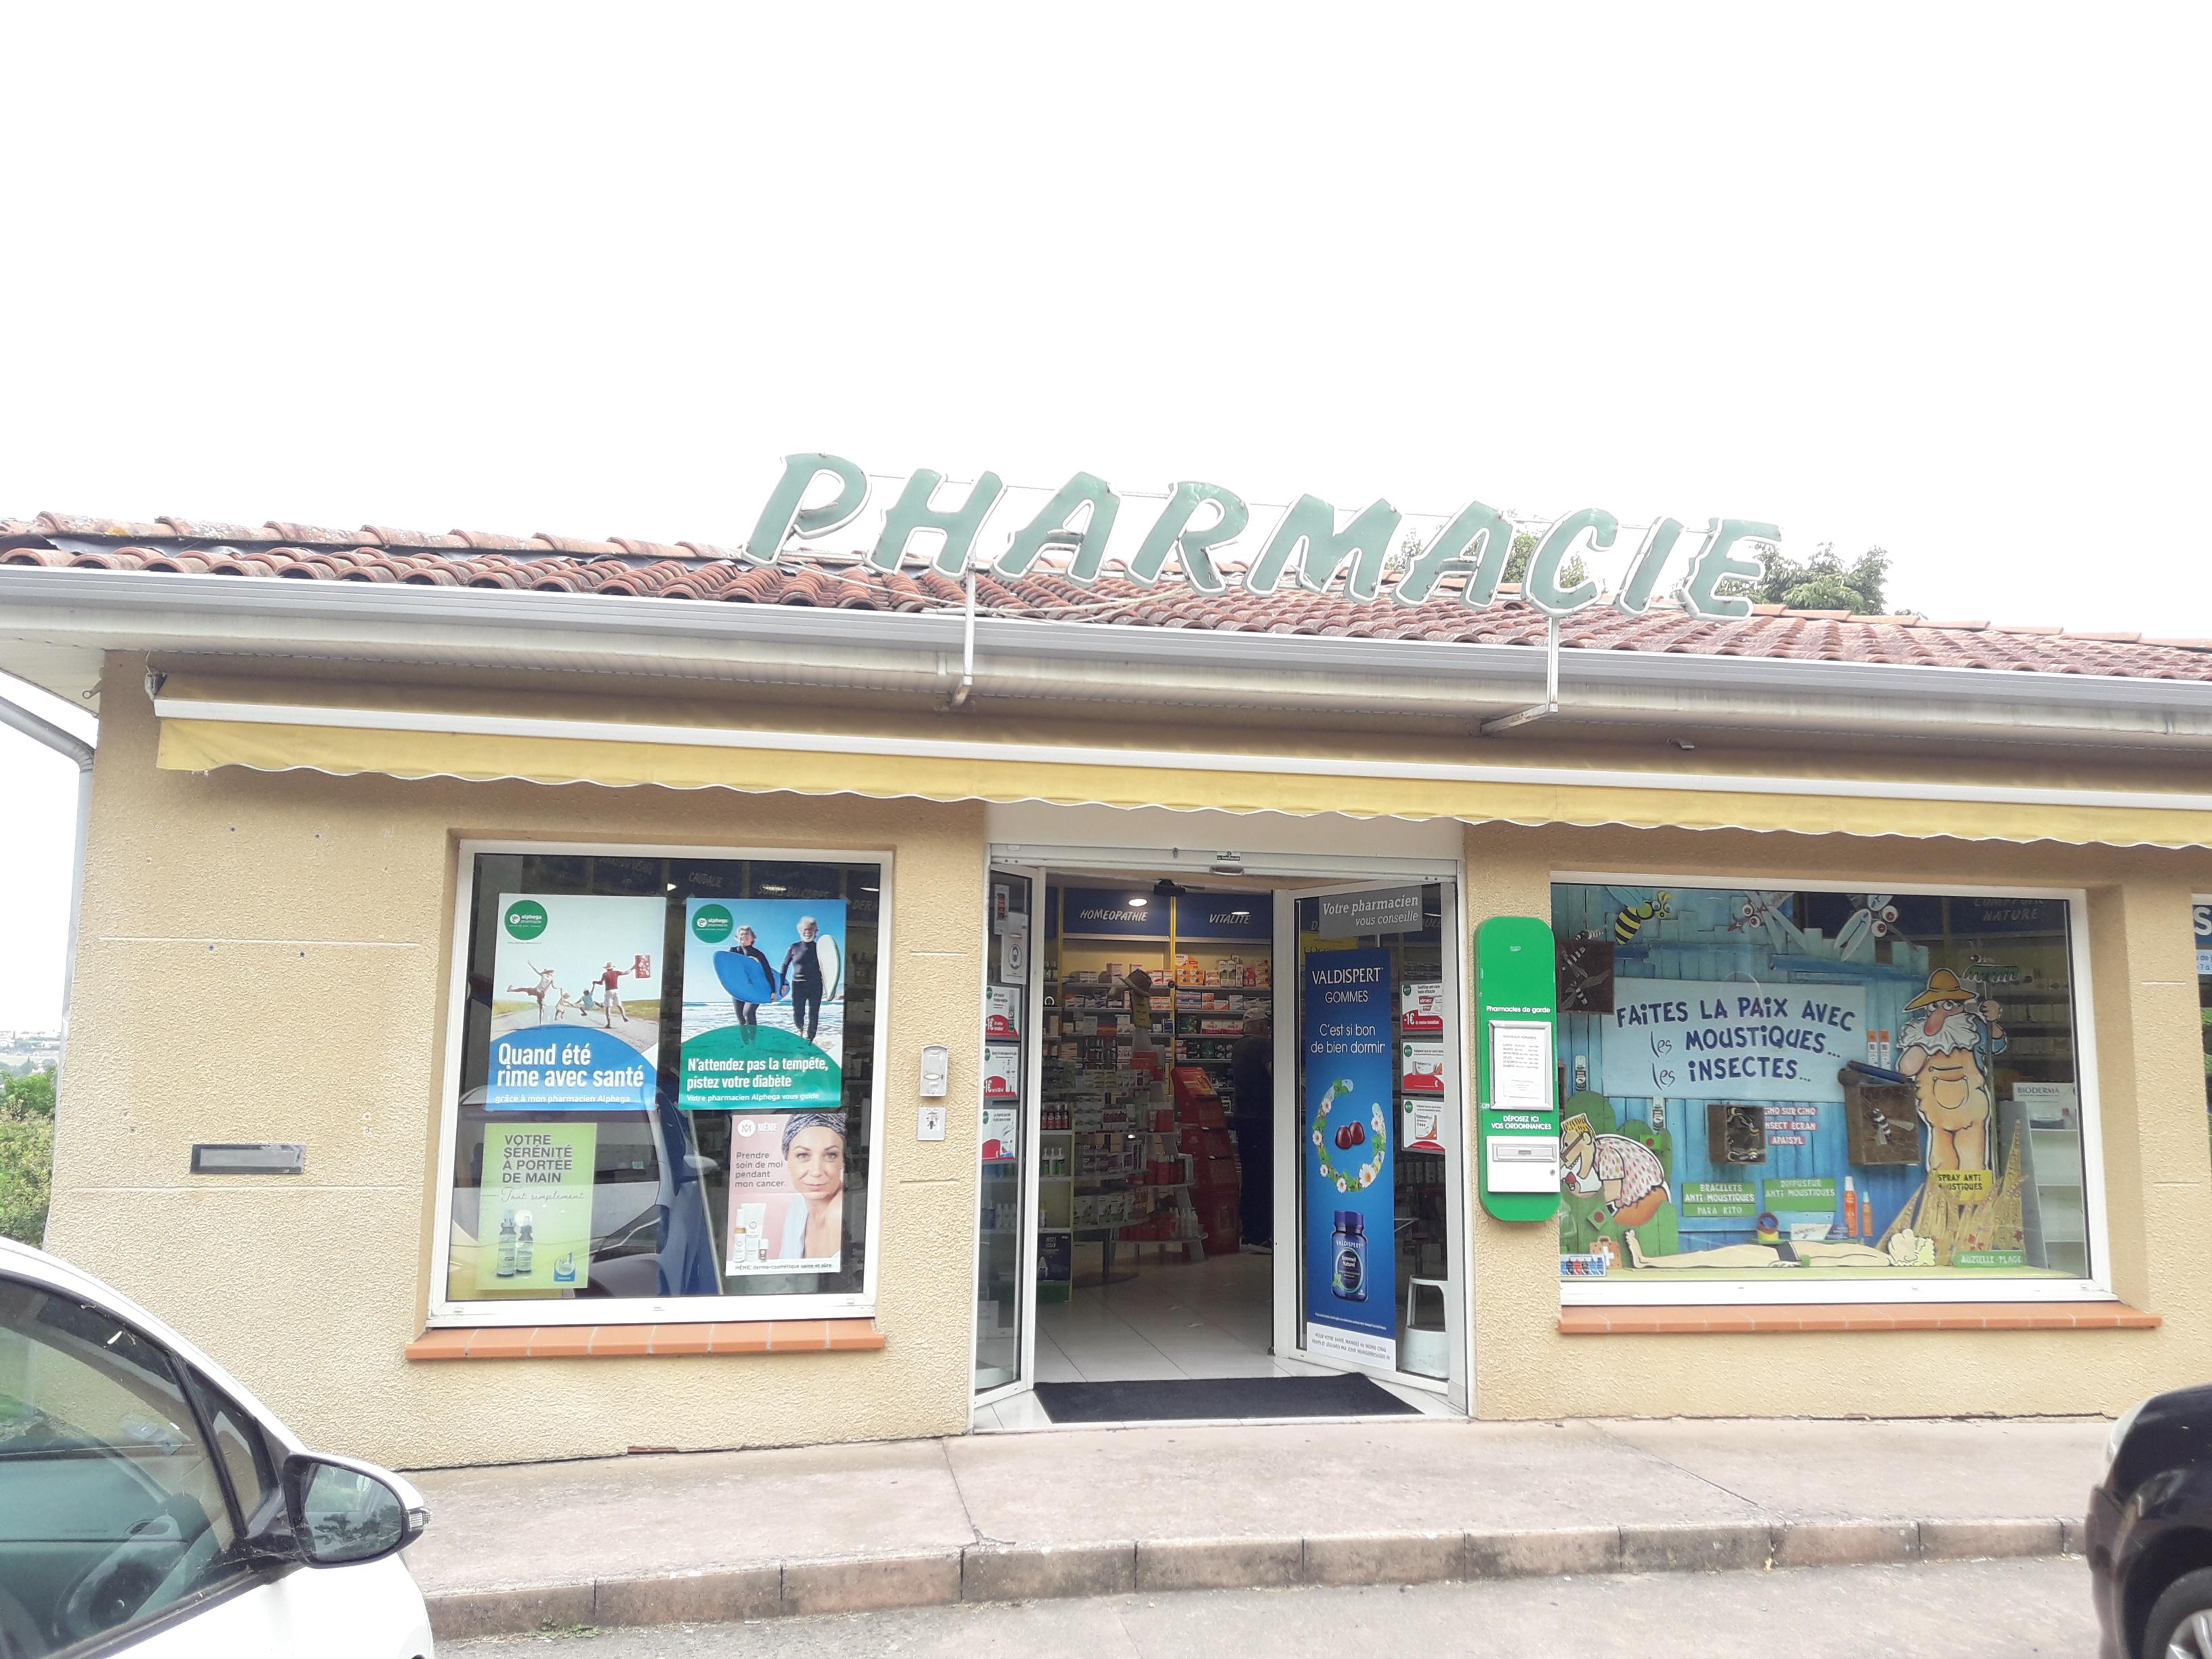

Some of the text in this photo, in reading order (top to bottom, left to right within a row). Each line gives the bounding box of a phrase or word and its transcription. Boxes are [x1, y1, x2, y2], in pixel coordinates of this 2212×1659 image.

[742, 452, 1782, 621] PHARMACIE
[1323, 895, 1418, 916] Votre pharmacien
[1080, 909, 1148, 922] HOMEOPATHIE
[1355, 916, 1376, 926] vous
[1377, 911, 1418, 924] conseille
[1984, 909, 2039, 921] NATURE
[1325, 990, 1368, 1003] GOMMES
[1700, 999, 1728, 1019] LA
[1801, 1000, 1856, 1031] AVEC
[1319, 1023, 1376, 1036] C'est si bon
[1311, 1041, 1324, 1053] de
[1326, 1041, 1348, 1053] bien
[1651, 1031, 1673, 1058] les
[498, 1043, 591, 1065] Quand été
[688, 1057, 829, 1073] N'attendez pas la tempête,
[497, 1065, 644, 1088] rime avec santé
[687, 1075, 792, 1091] pistez votre diabète
[1652, 1063, 1675, 1091] les
[495, 1095, 518, 1103] grâce
[548, 1095, 596, 1103] pharmacien
[597, 1094, 630, 1103] Alphega
[1781, 1107, 1796, 1115] SUR
[1792, 1122, 1816, 1130] ECRAN
[504, 1134, 552, 1145] VOTRE
[504, 1145, 573, 1158] SÉRÉNITÉ
[516, 1157, 573, 1170] PORTÉE
[502, 1172, 561, 1183] DE MAIN
[735, 1170, 771, 1179] pendant
[501, 1187, 585, 1202] Tout simplement
[1700, 1184, 1743, 1192] BRACELETS
[1697, 1206, 1717, 1215] PARA
